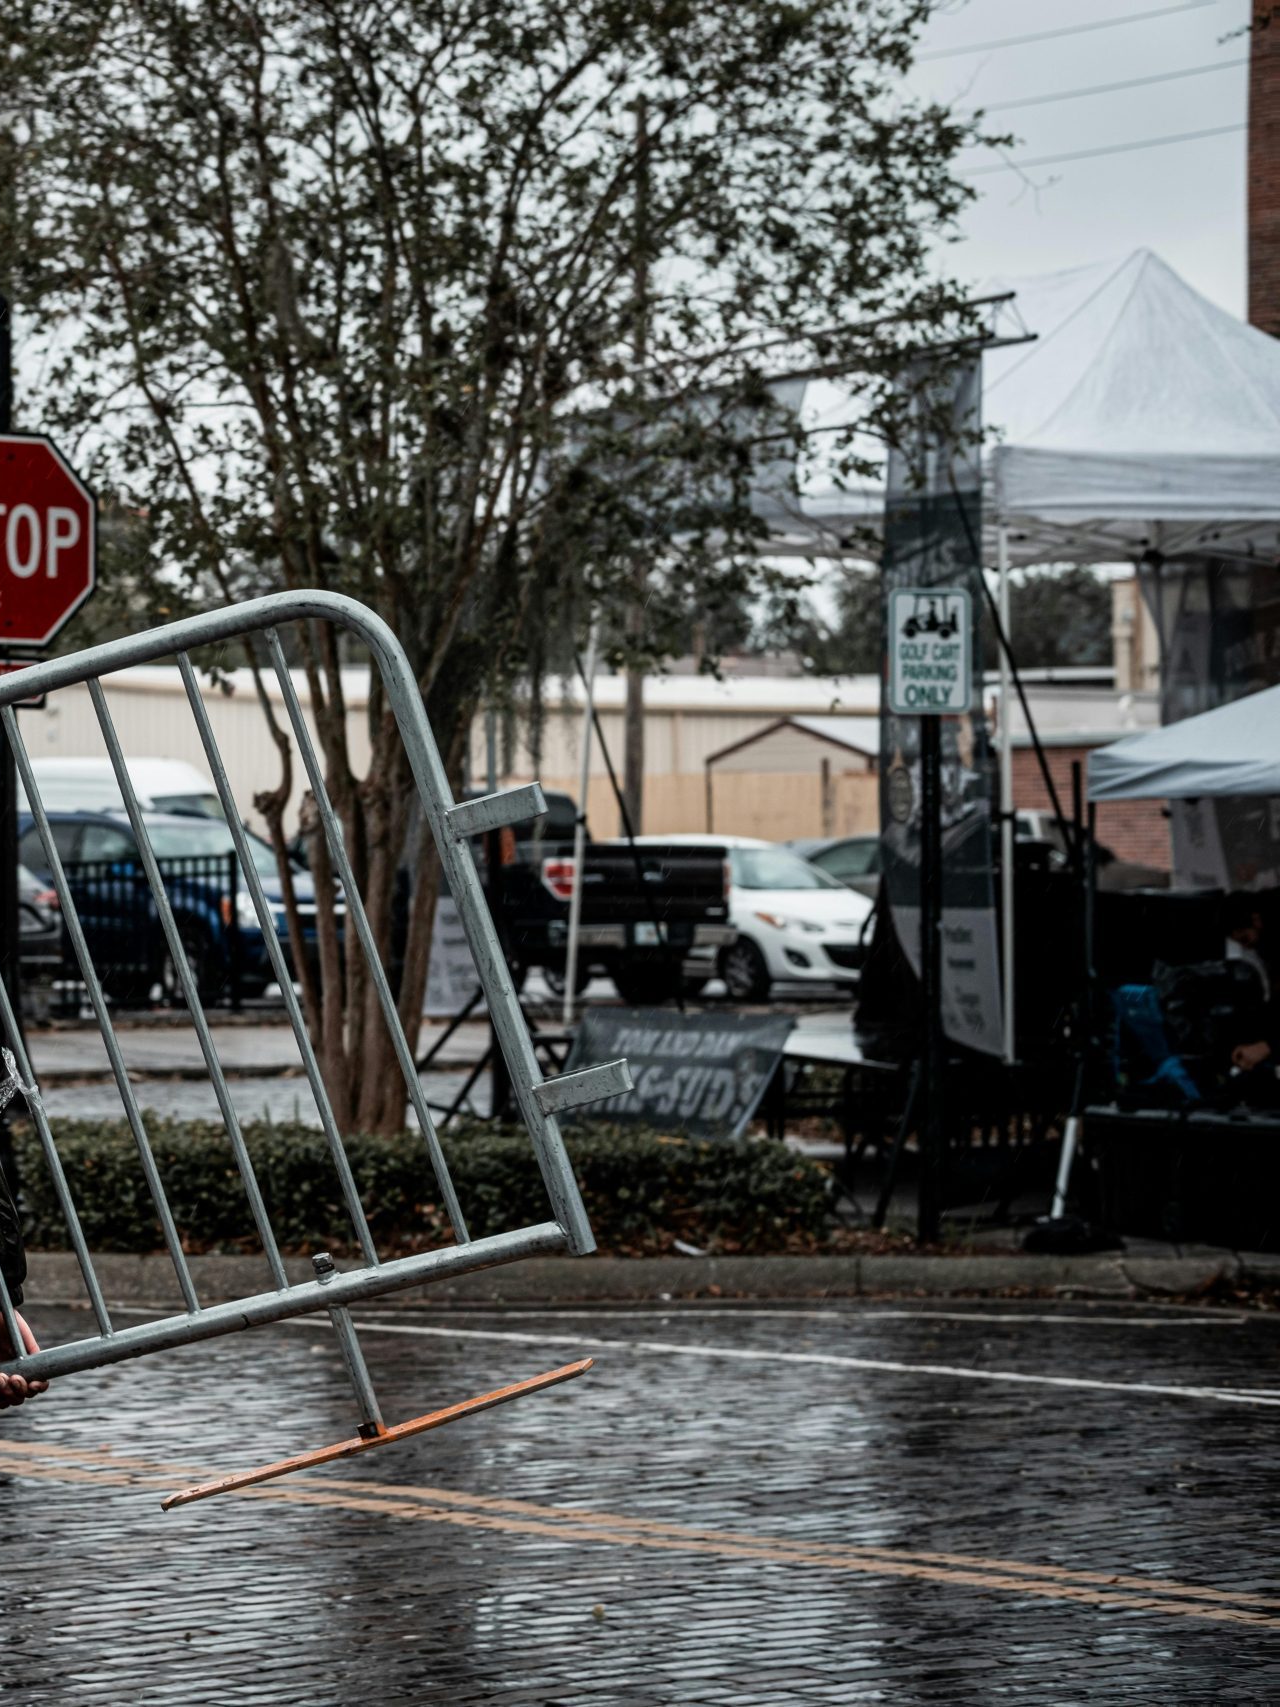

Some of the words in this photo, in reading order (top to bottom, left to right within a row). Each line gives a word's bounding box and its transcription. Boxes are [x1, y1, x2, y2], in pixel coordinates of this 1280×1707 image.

[900, 643, 928, 660] GOLF
[931, 642, 961, 660] CART
[901, 663, 958, 680] PARKING
[904, 684, 952, 706] ONLY
